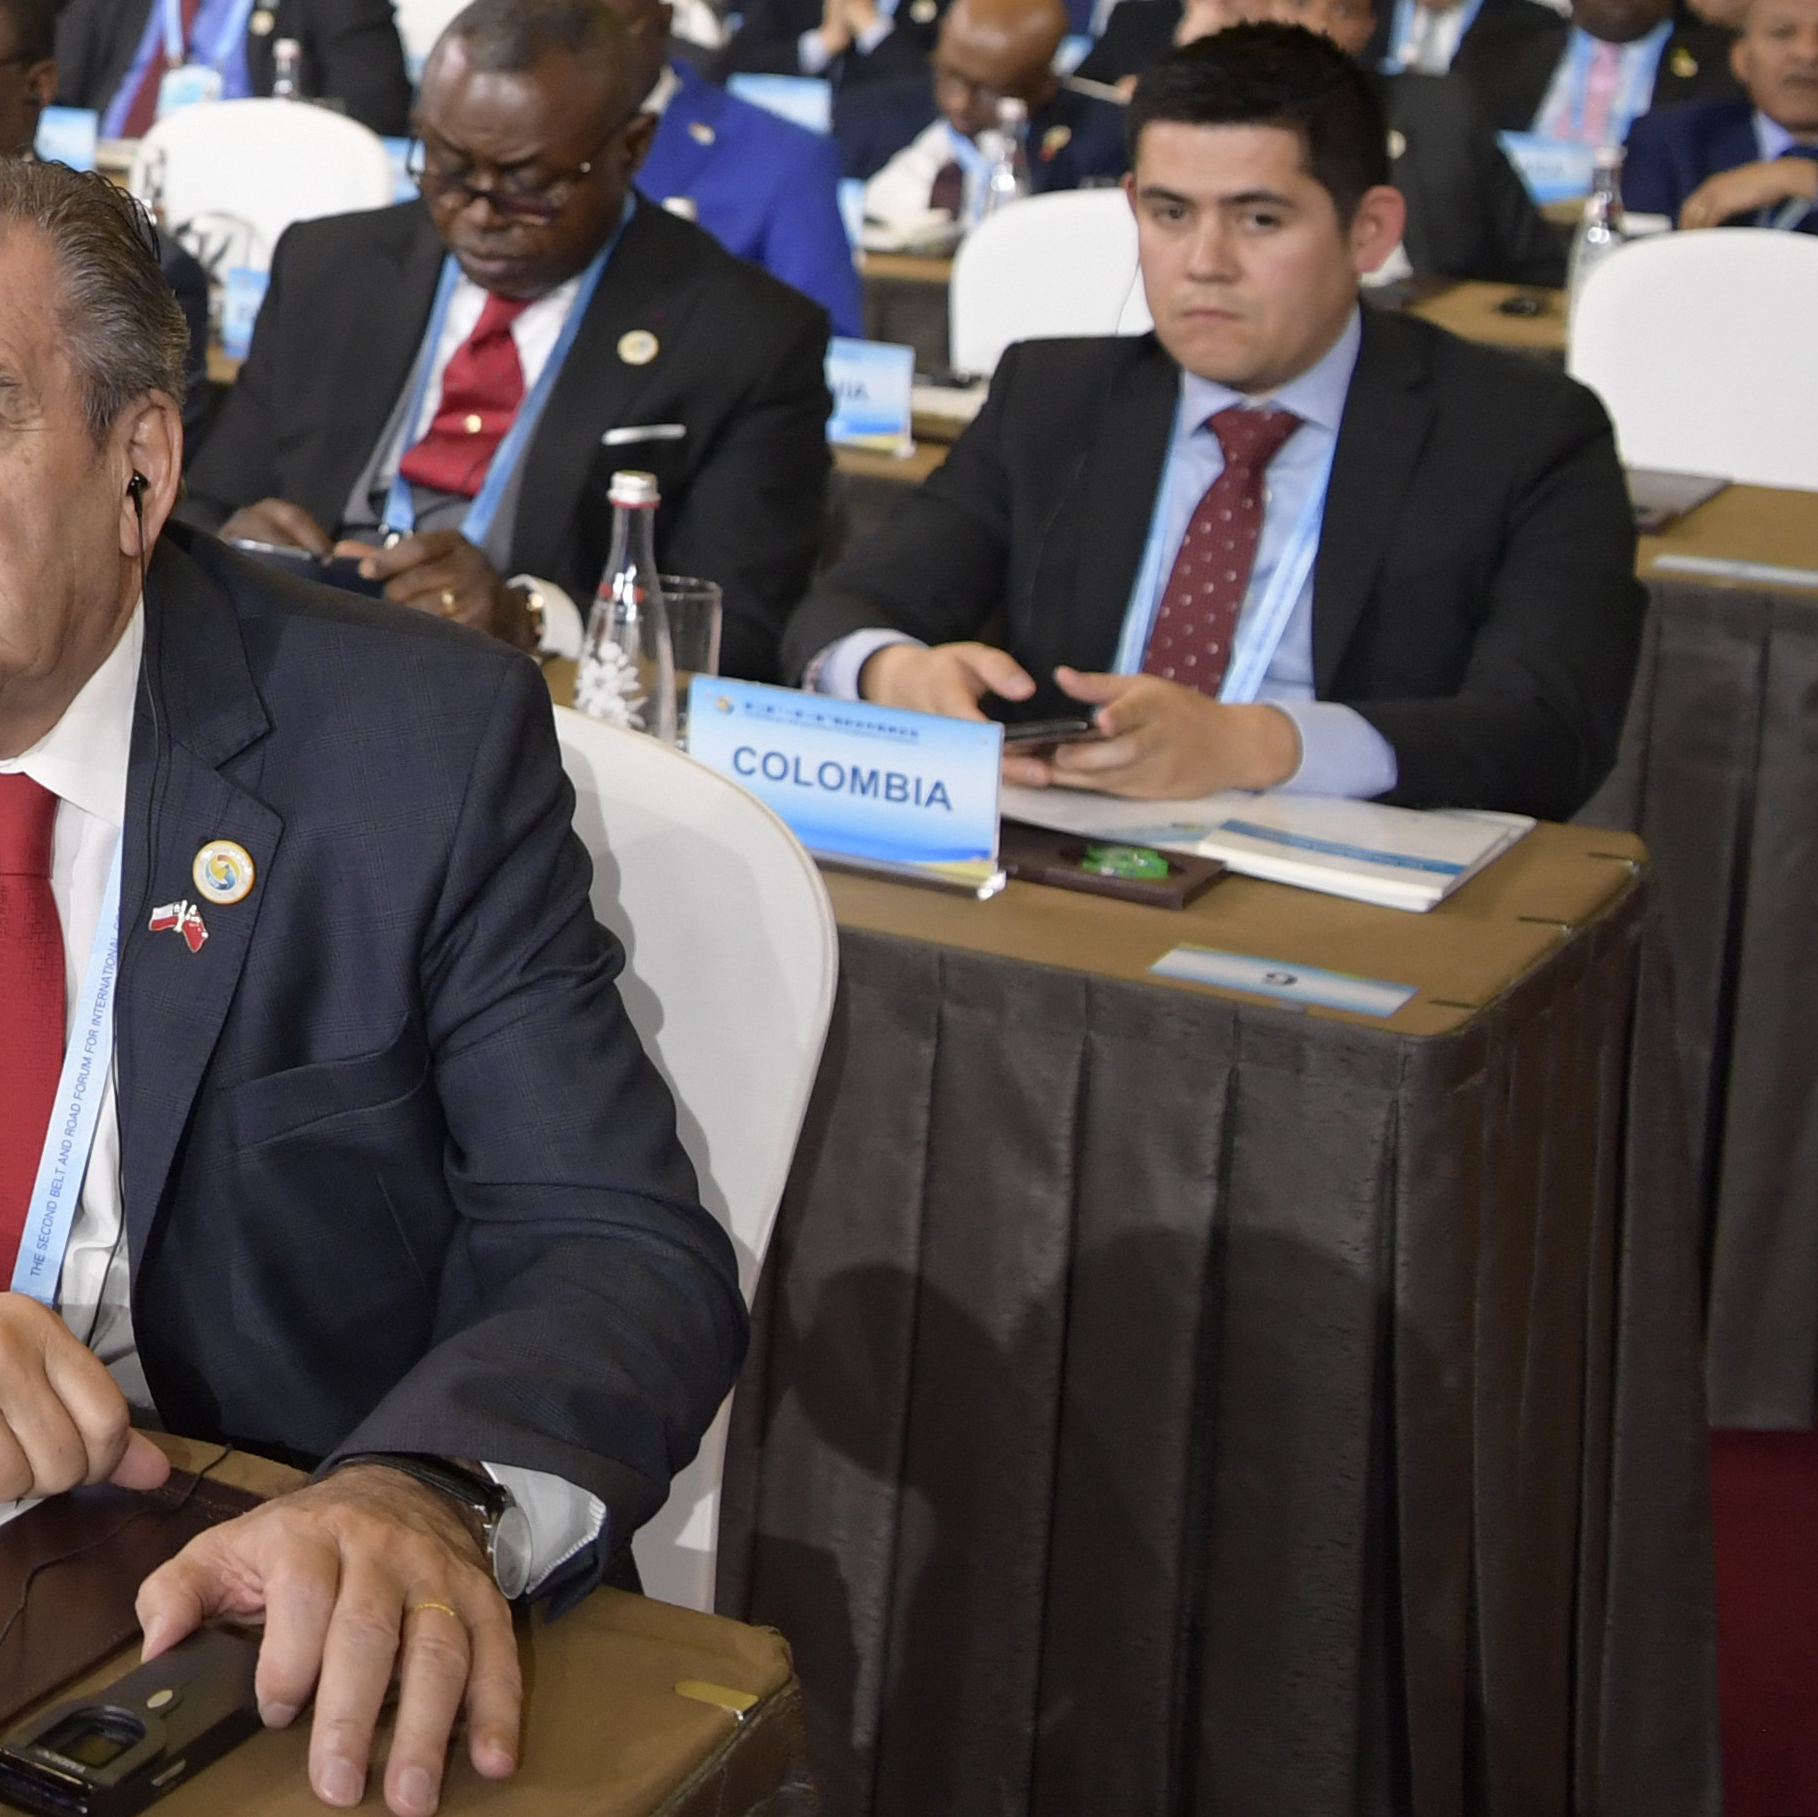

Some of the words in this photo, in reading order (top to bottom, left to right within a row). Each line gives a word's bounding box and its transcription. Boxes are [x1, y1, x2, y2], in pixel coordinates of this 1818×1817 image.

[732, 746, 953, 812] COLOMBIA
[83, 1028, 99, 1053] FOR
[73, 1056, 92, 1100] FORUM
[65, 1102, 81, 1137] ROAD
[58, 1139, 73, 1165] AND
[49, 1167, 65, 1198] BELT
[36, 1199, 58, 1251] SECOND
[29, 1253, 46, 1278] THE
